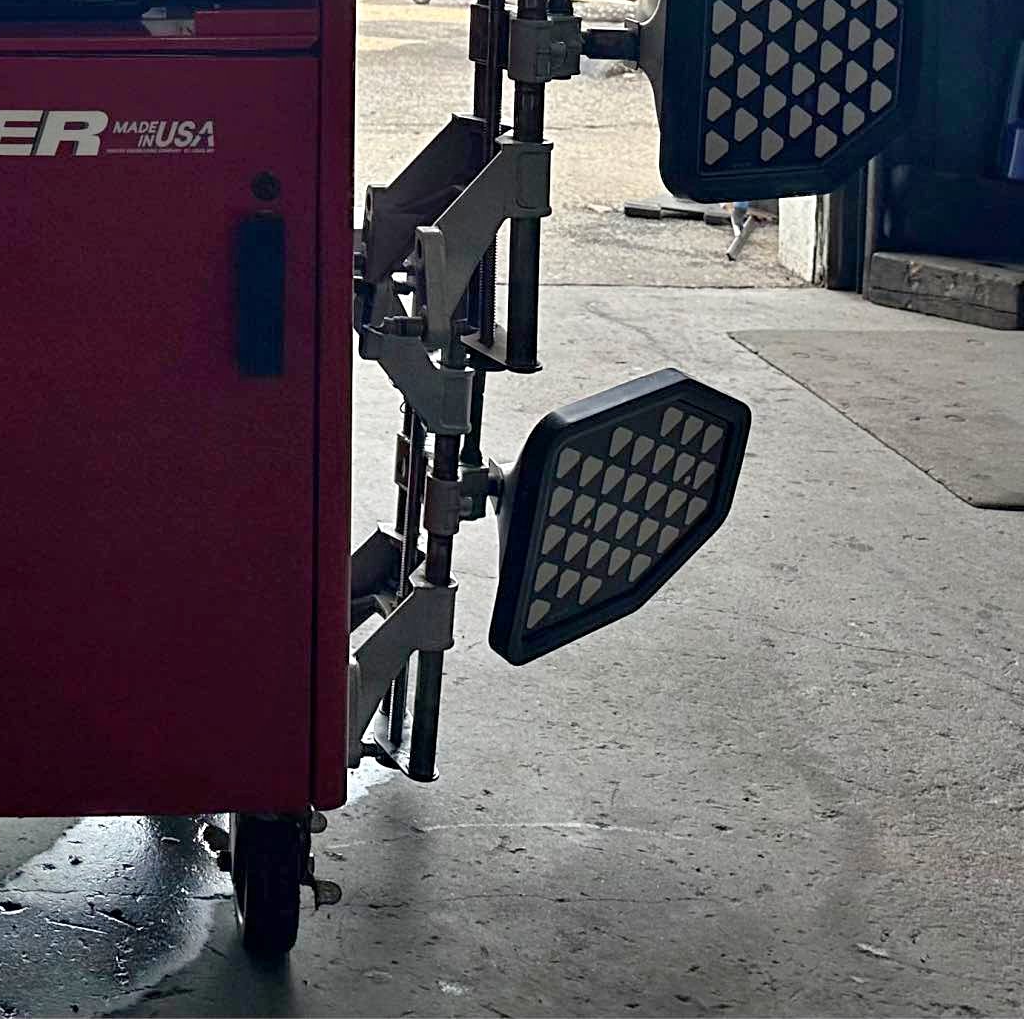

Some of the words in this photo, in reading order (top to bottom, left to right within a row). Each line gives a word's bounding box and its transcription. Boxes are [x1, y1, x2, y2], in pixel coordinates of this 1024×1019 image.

[112, 121, 159, 134] MADE
[155, 120, 215, 148] USA
[138, 135, 156, 148] IN
